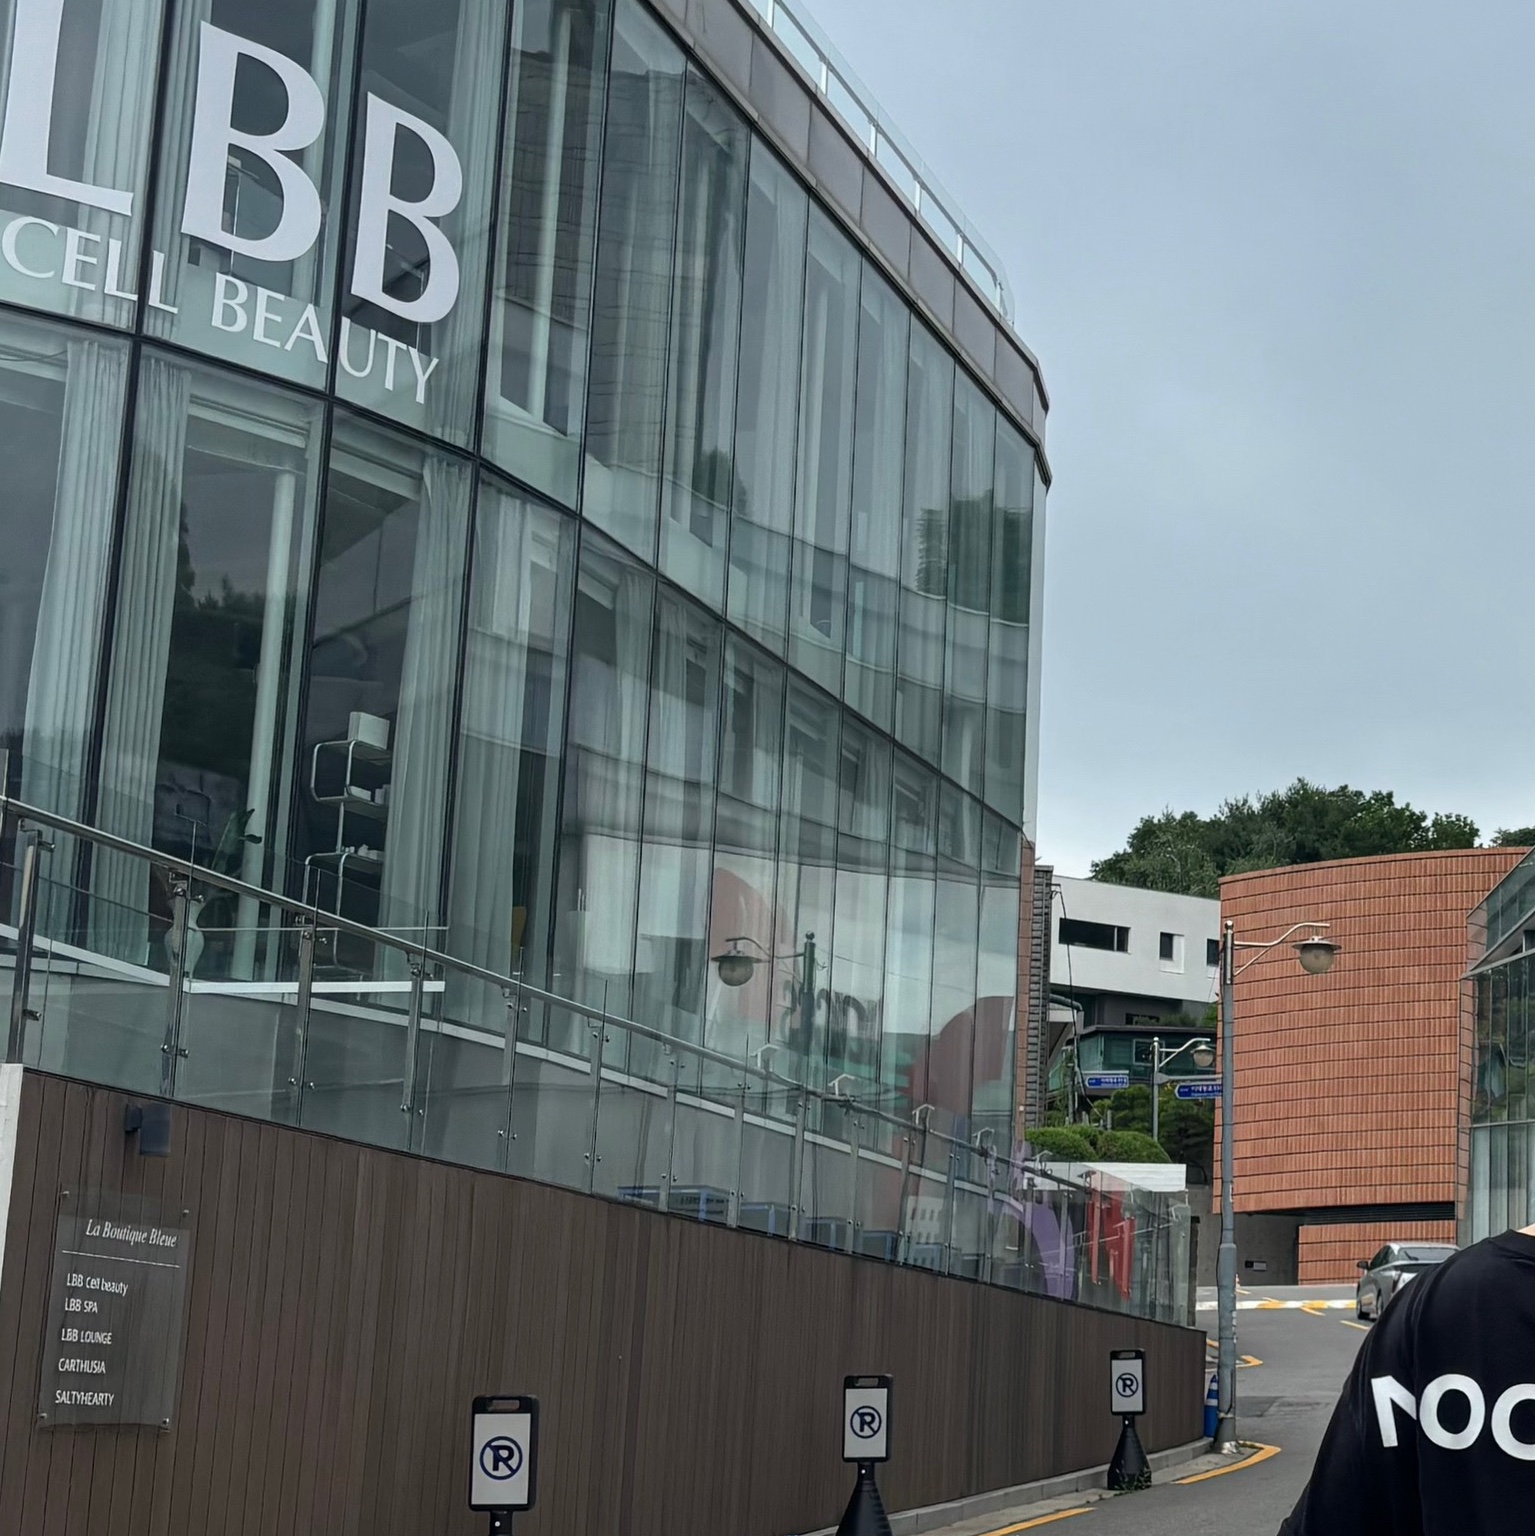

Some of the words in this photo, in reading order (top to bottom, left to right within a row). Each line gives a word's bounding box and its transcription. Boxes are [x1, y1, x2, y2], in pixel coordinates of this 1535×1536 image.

[2, 215, 178, 314] CELL
[211, 271, 440, 405] BEAUTY
[86, 1218, 100, 1236] La
[102, 1221, 147, 1246] Boutique
[148, 1228, 177, 1247] Bleue
[66, 1273, 83, 1287] LBB
[65, 1297, 81, 1311] LBB
[84, 1300, 98, 1314] SPA
[61, 1328, 78, 1342] LBB
[80, 1330, 112, 1344] LOUNGE
[58, 1358, 106, 1374] CARTHUSIA
[55, 1389, 115, 1406] SALTYHEARTY
